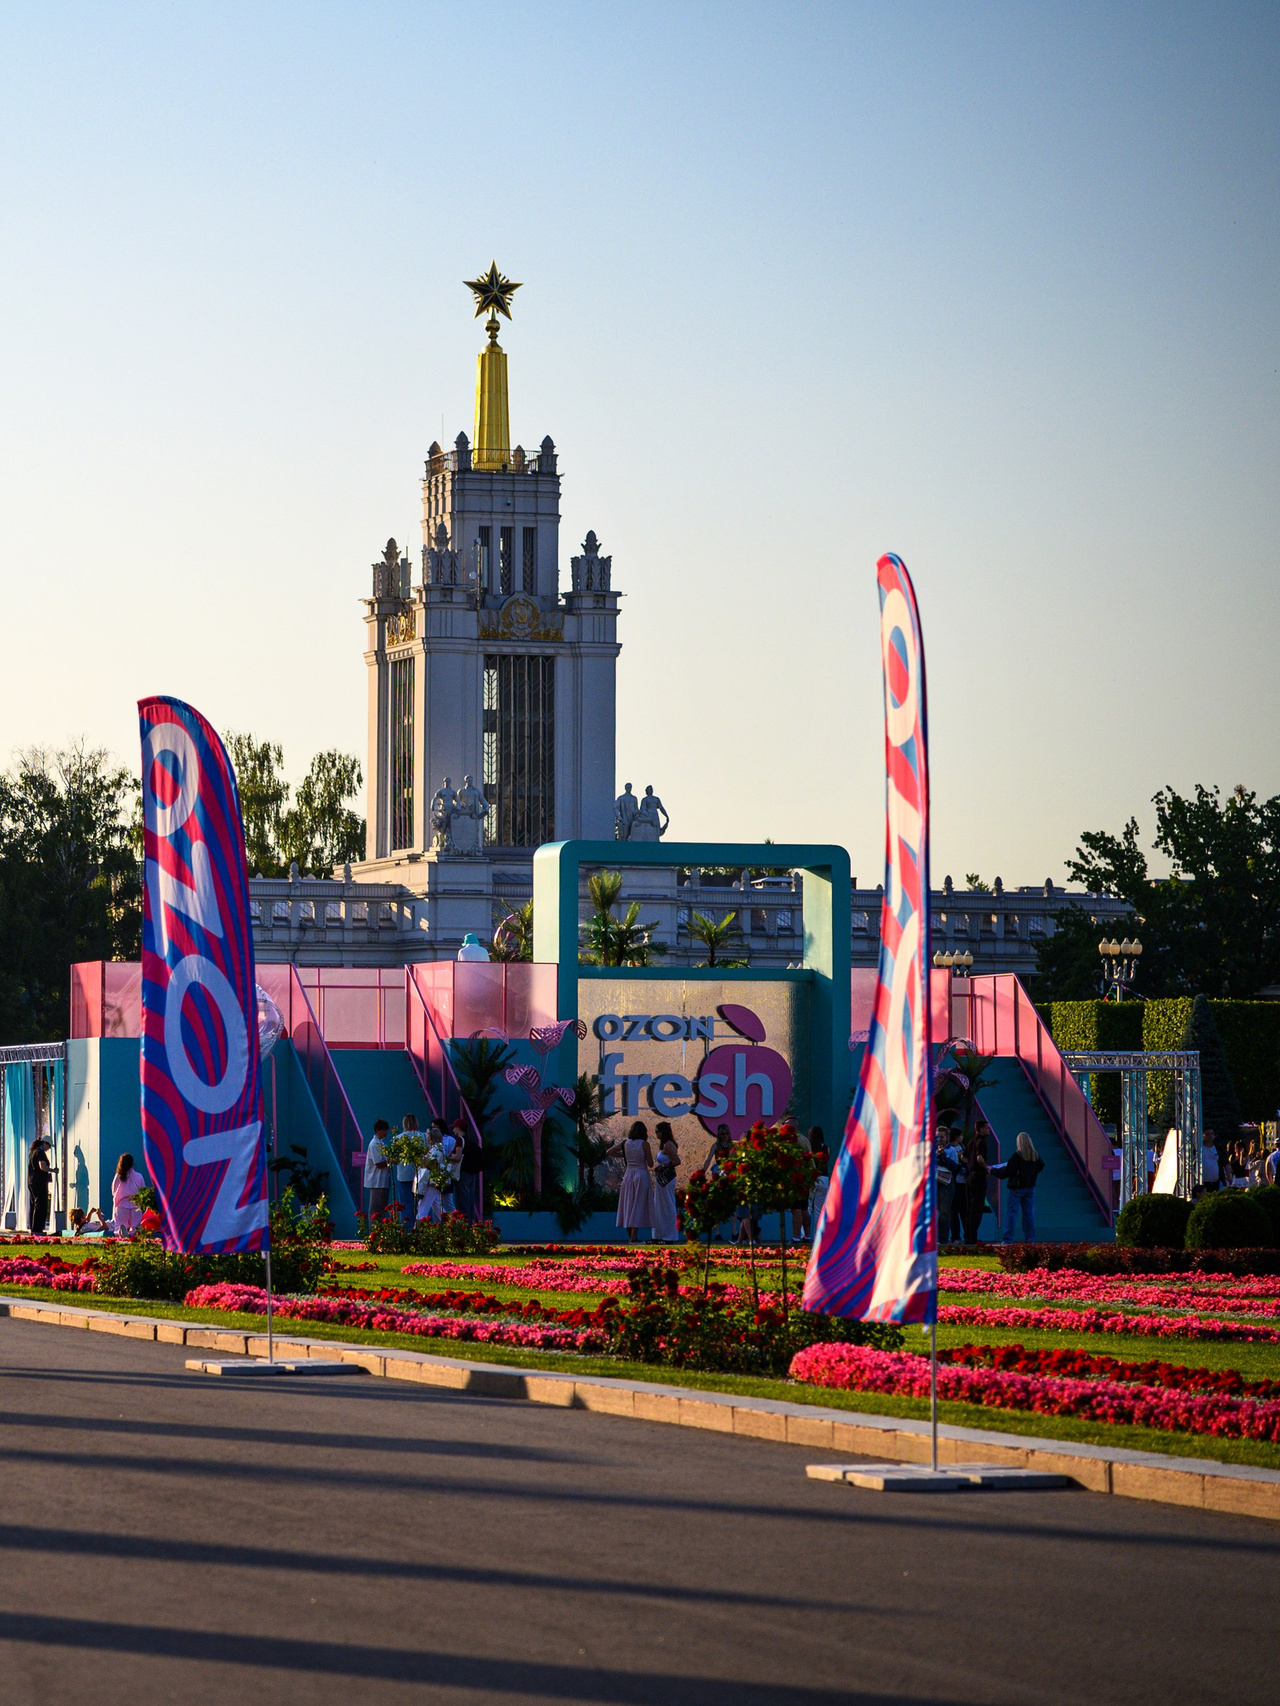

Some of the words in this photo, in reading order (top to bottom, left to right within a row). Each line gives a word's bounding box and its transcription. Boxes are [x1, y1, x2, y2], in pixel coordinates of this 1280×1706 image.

[142, 722, 267, 1244] OZON
[597, 1013, 715, 1042] OZON
[598, 1052, 774, 1118] fresh
